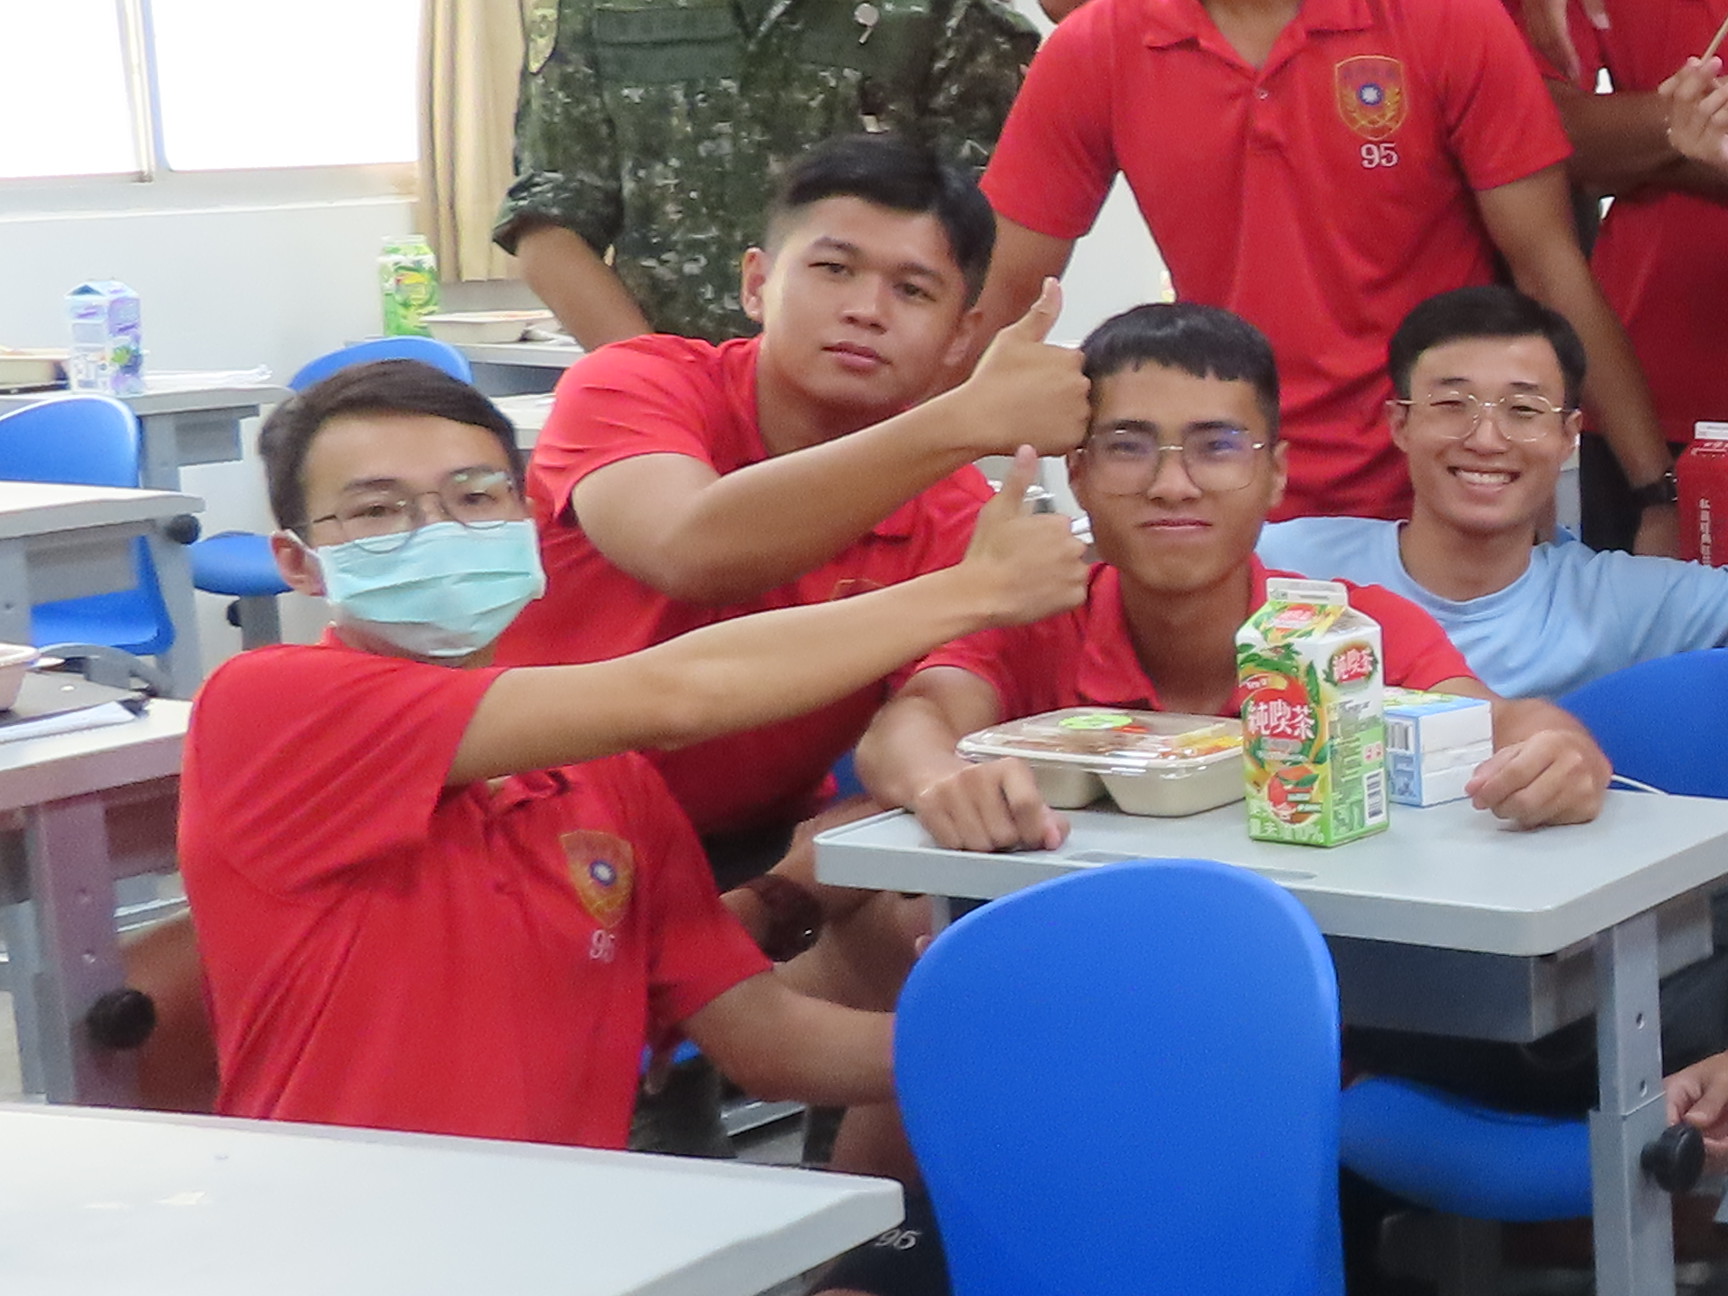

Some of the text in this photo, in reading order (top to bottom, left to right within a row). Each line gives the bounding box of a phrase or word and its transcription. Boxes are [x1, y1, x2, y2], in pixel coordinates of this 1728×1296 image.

[1360, 142, 1399, 168] 95
[1246, 698, 1315, 739] 純喫茶
